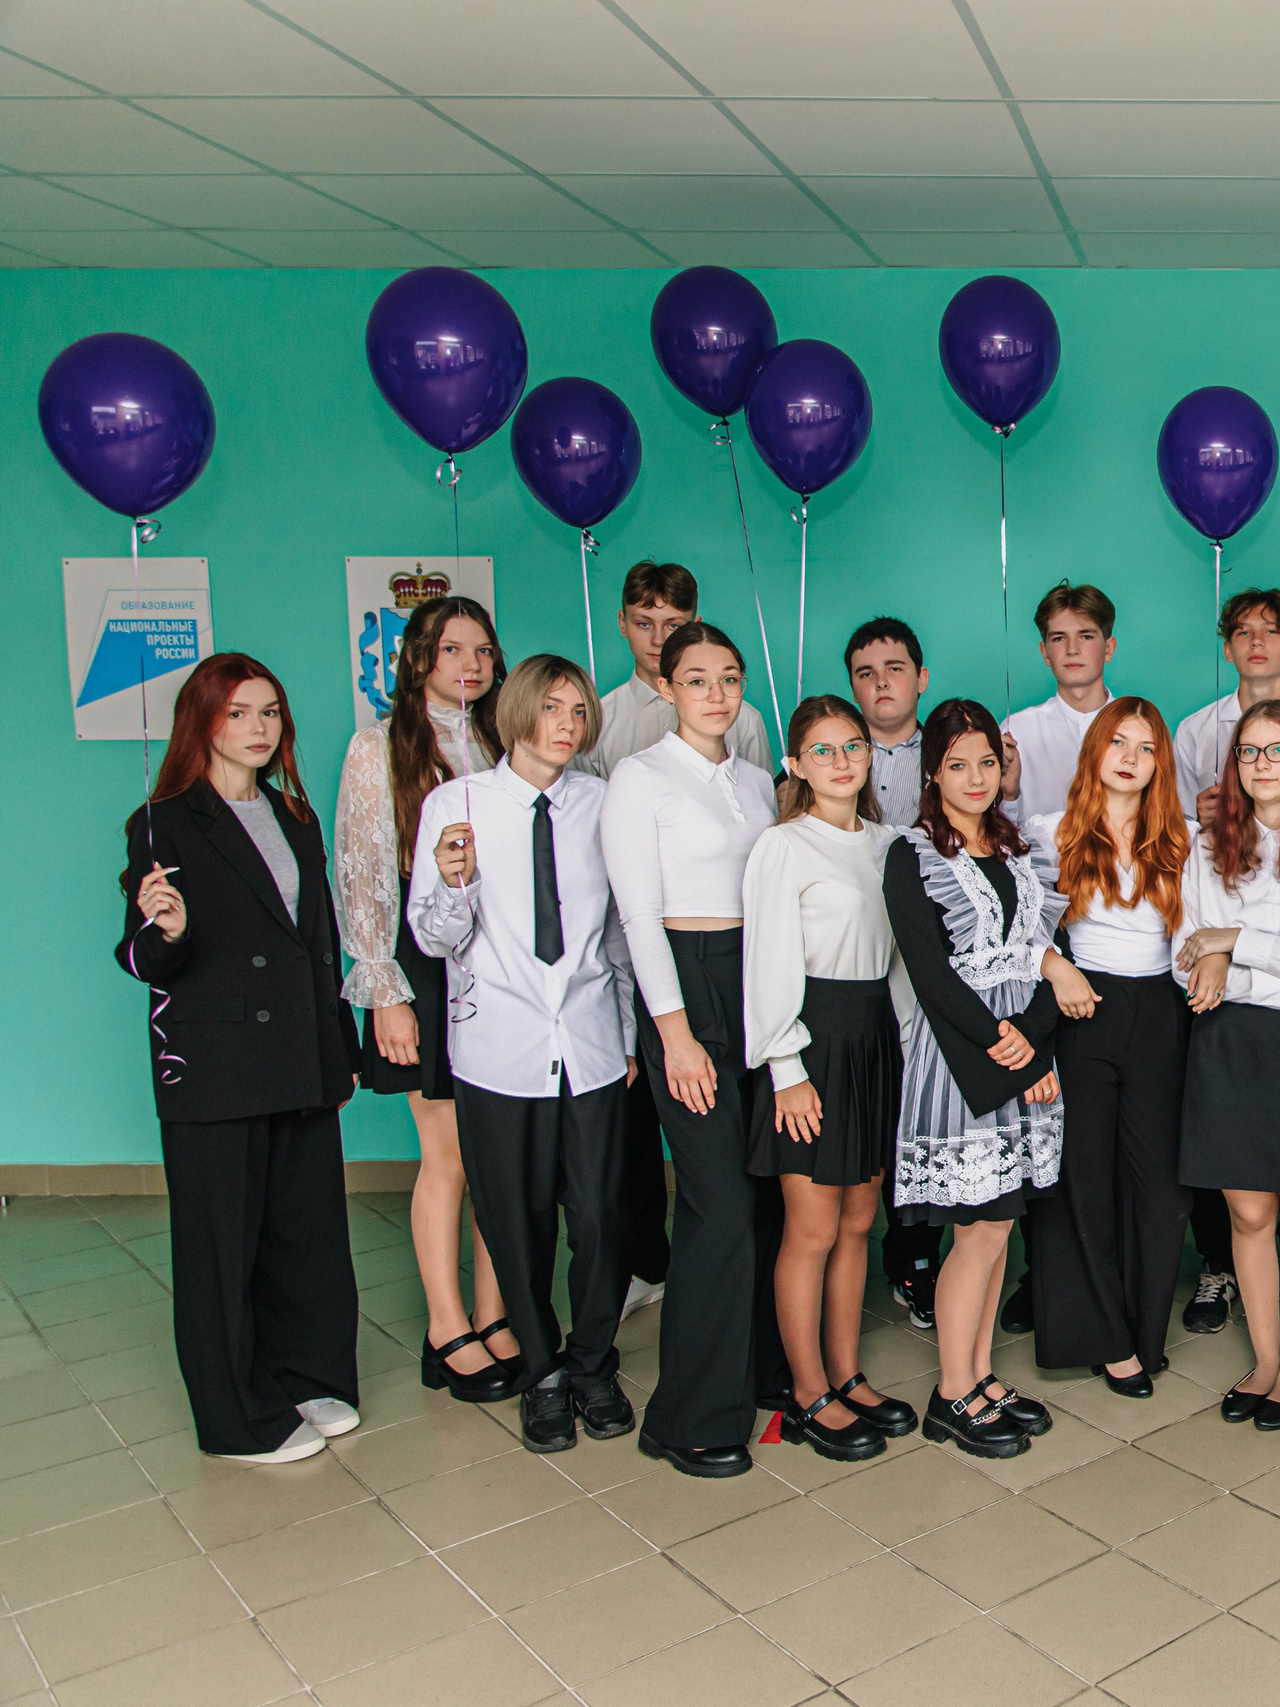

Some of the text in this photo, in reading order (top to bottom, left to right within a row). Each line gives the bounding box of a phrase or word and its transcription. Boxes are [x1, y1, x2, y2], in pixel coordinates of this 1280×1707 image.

[109, 621, 194, 634] НАЦИОНАЛЬНЫЕ
[146, 634, 195, 646] ПРОЕКТЫ
[155, 648, 196, 659] РОССИИ
